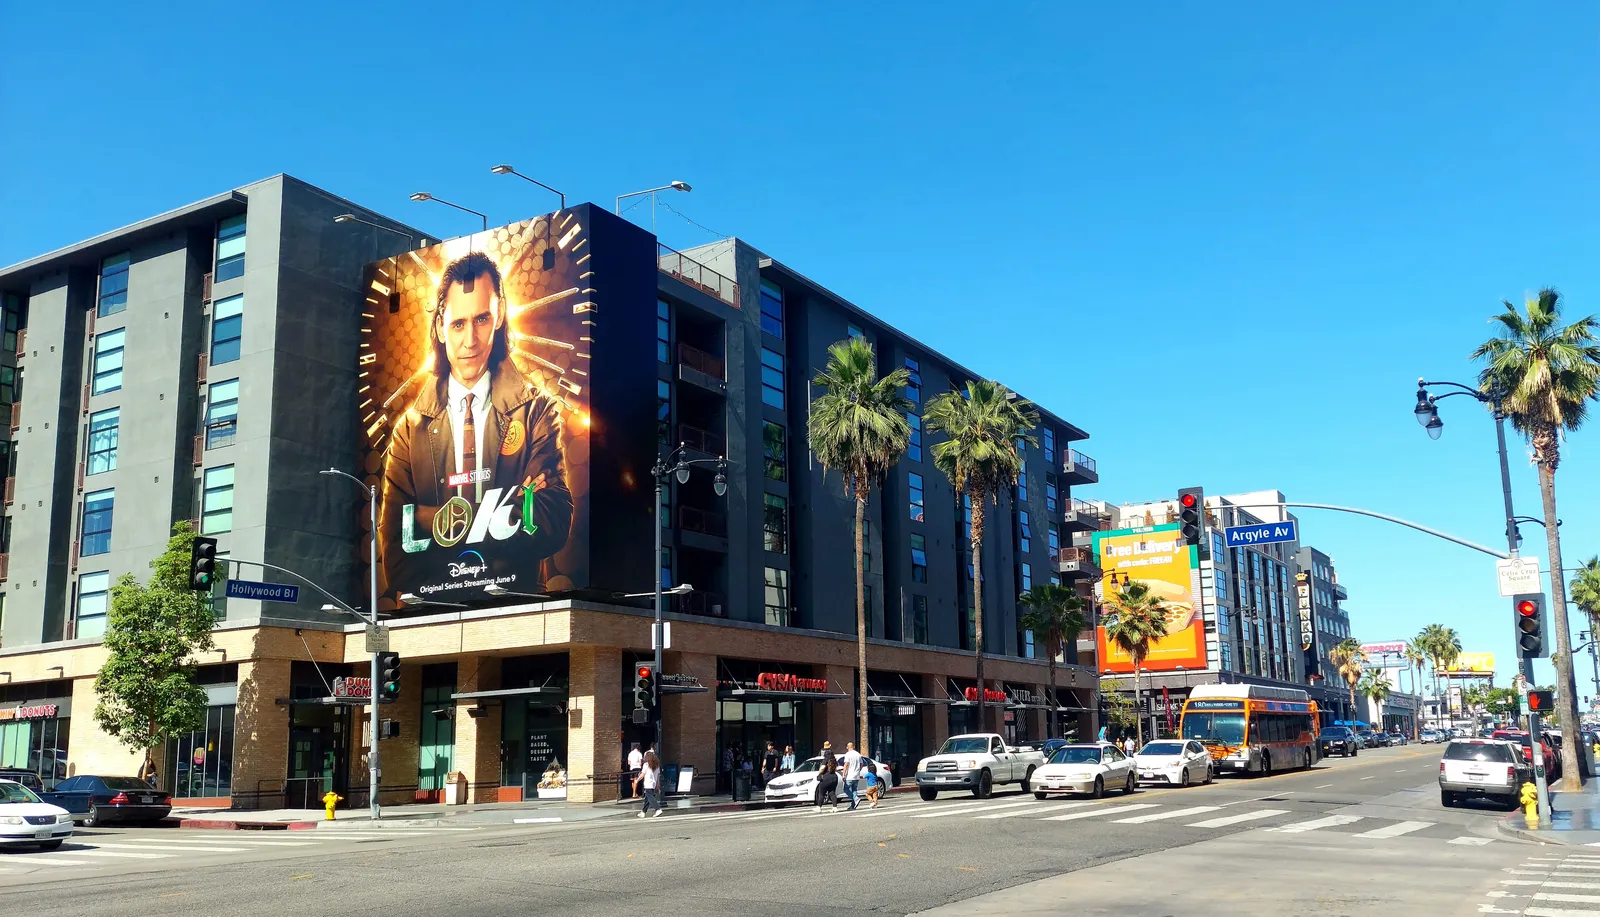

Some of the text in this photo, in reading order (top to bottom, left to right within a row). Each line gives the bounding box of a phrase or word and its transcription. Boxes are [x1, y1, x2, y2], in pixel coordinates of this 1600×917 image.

[401, 481, 538, 553] LOKI
[1232, 526, 1289, 543] Argyle Av
[1107, 540, 1180, 558] Free Delivery
[1117, 560, 1132, 568] with
[231, 583, 294, 598] Hollywood Bl
[420, 574, 516, 594] Original Series Streaming June 9
[21, 704, 56, 718] DONUTS
